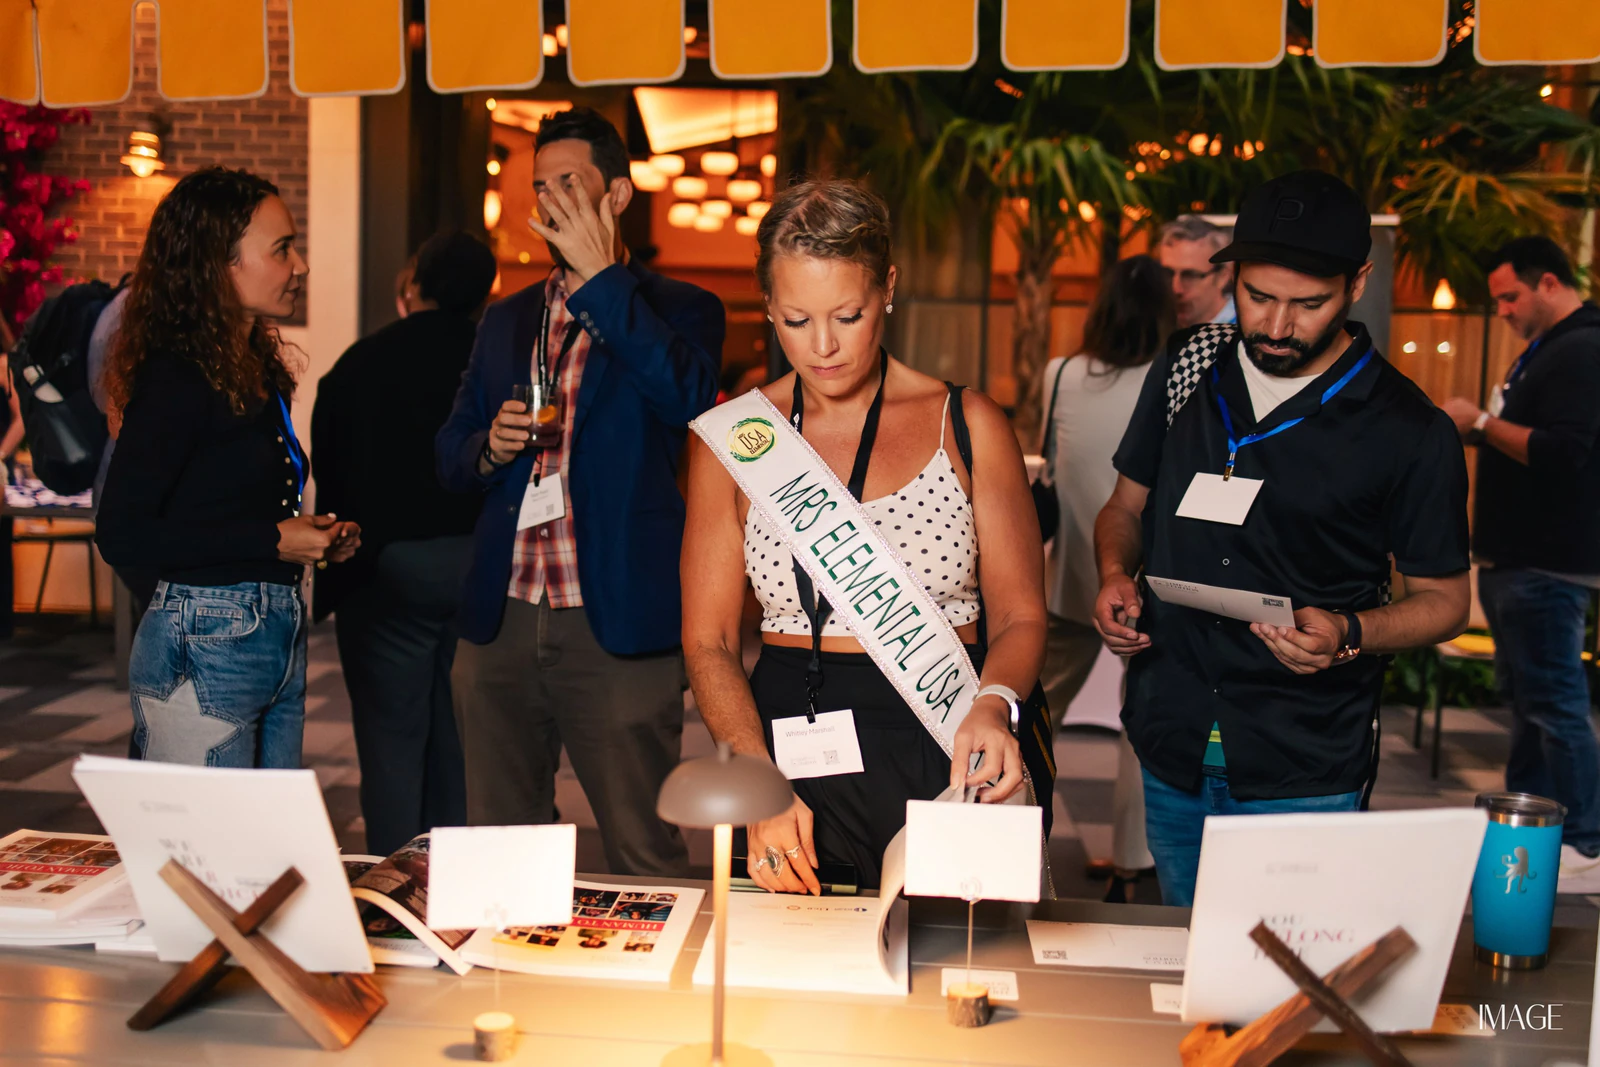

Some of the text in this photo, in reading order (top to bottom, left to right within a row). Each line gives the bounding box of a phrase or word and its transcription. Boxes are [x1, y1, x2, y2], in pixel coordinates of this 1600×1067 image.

[740, 428, 767, 450] USA
[769, 470, 966, 723] MRS ELEMENTAL USA
[602, 921, 658, 930] HUMAN
